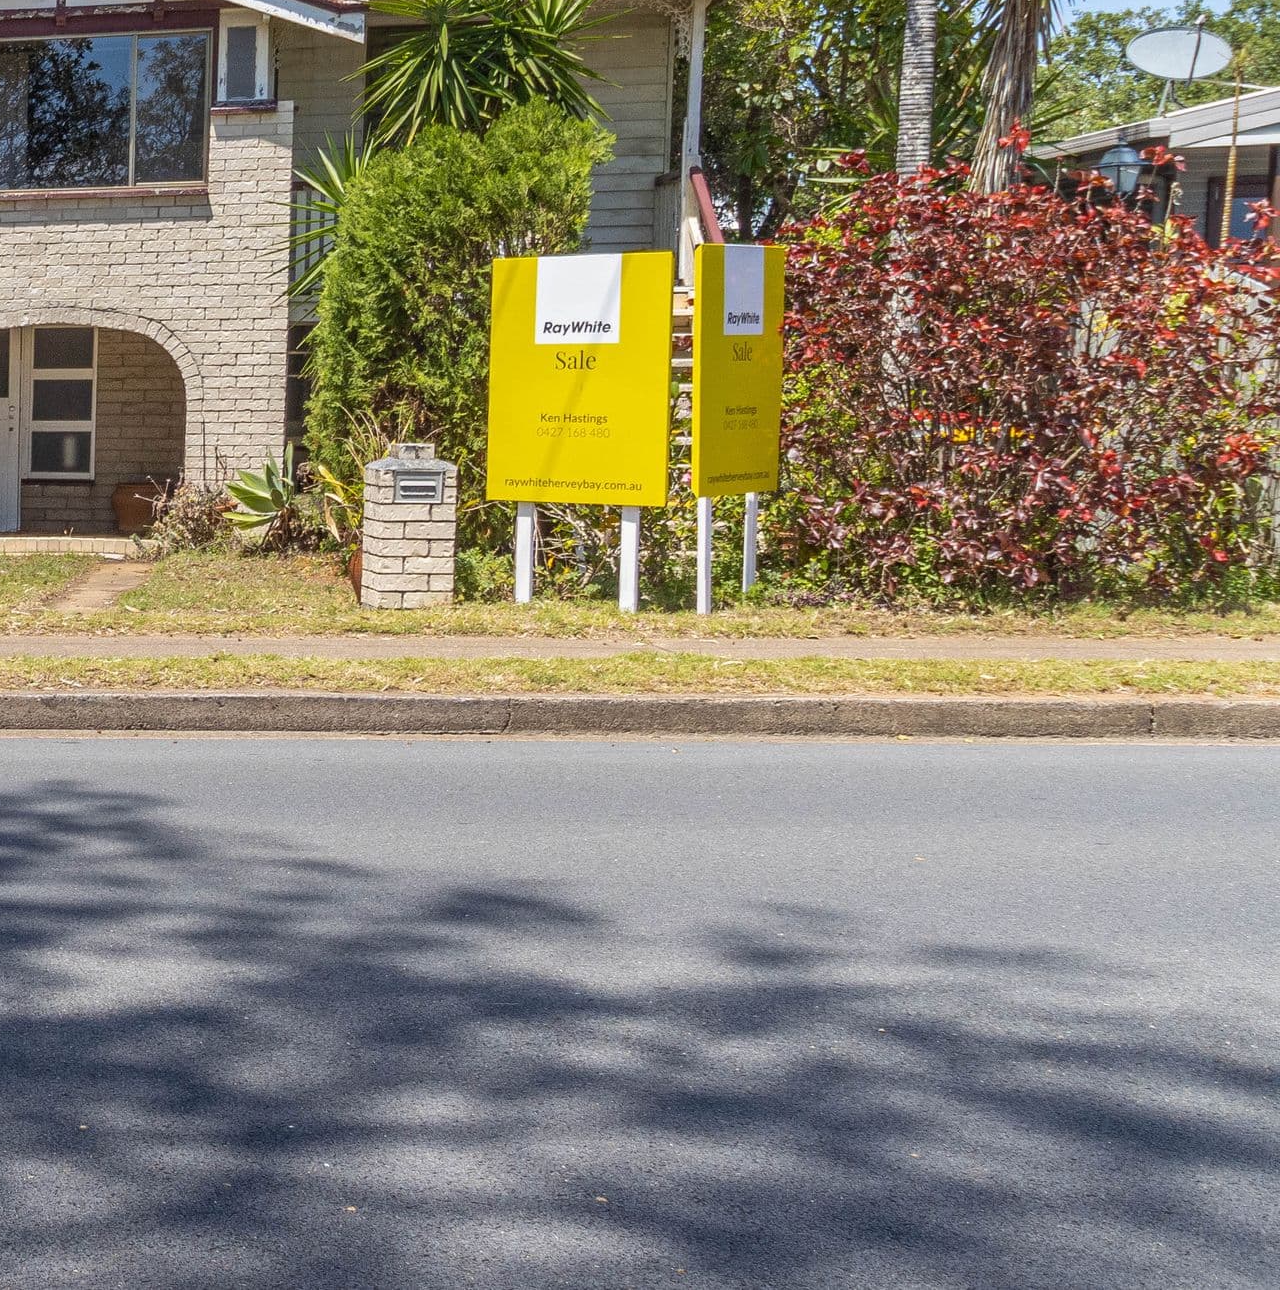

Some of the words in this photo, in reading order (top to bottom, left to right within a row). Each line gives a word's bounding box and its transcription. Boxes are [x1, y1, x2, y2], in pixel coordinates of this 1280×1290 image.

[727, 312, 760, 326] RayWhite
[543, 321, 611, 335] RayWhite
[732, 341, 753, 362] Sale
[555, 350, 596, 370] Sale
[540, 413, 560, 423] Ken
[563, 414, 608, 425] Hastings
[536, 427, 563, 437] 0427
[567, 428, 587, 438] 168
[589, 428, 610, 438] 480
[504, 477, 642, 491] raywhiteherveybay.com.au
